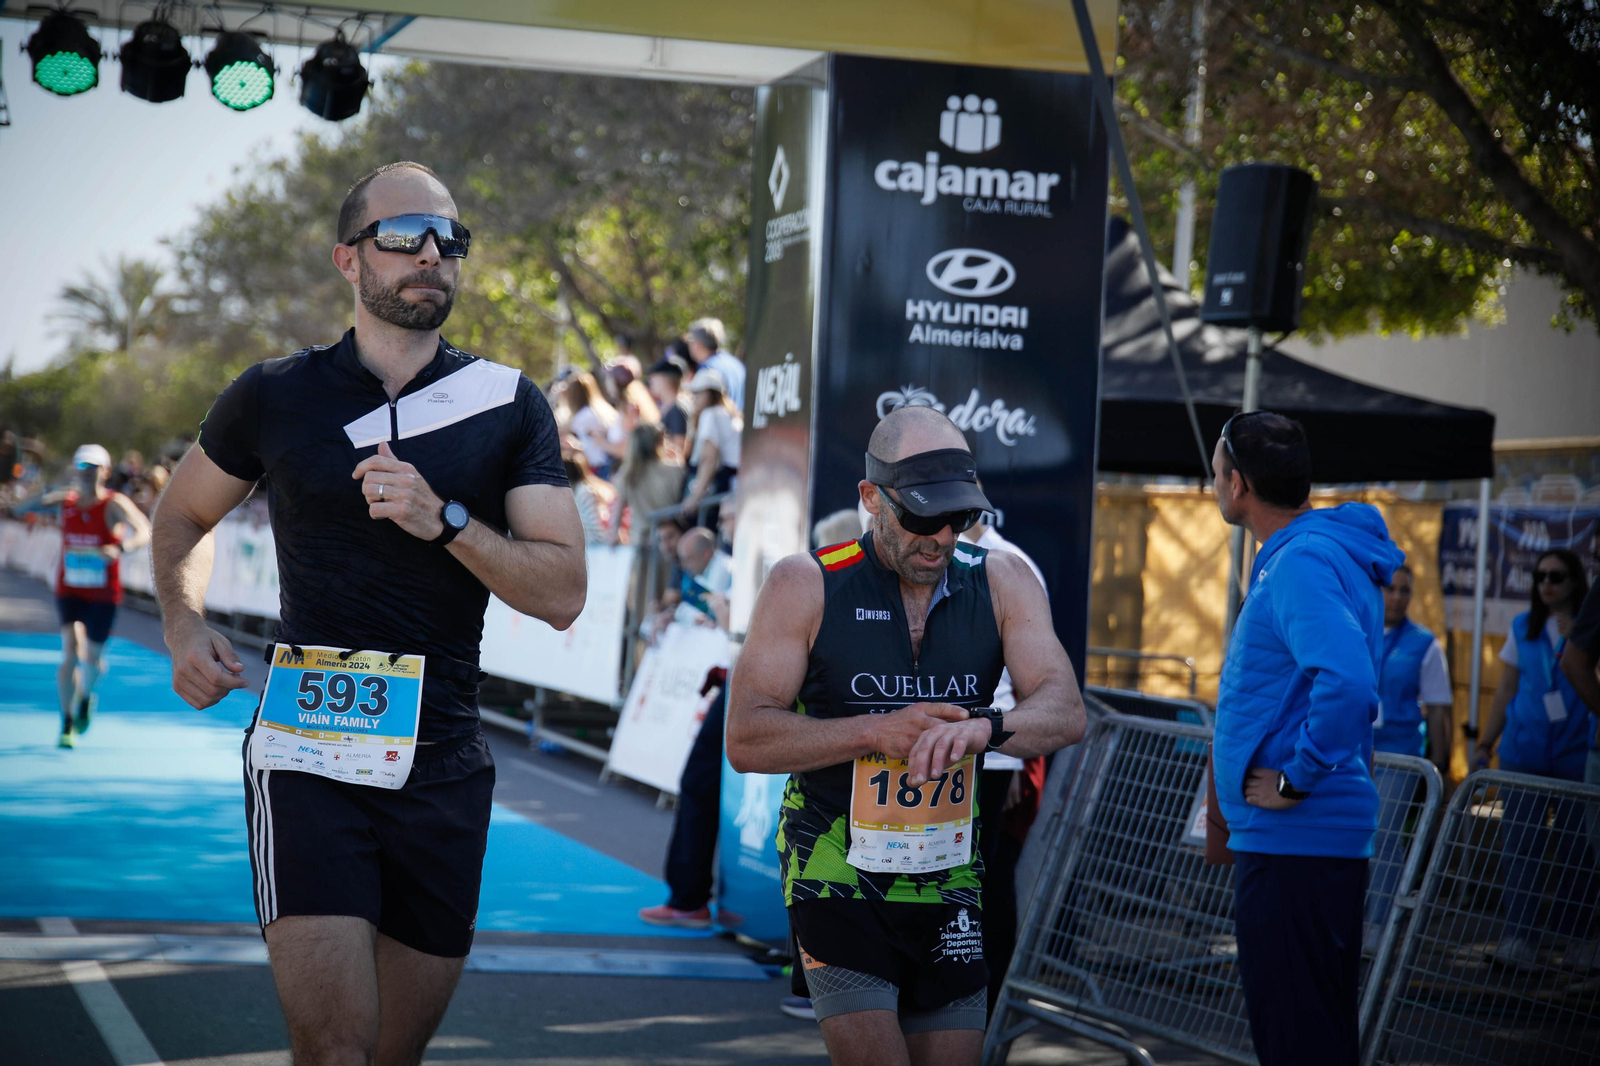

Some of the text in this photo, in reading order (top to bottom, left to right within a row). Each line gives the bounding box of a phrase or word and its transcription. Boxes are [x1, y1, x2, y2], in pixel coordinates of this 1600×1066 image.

[874, 151, 1060, 205] cajamar
[963, 197, 1053, 218] CAJA RURAL
[905, 299, 1028, 329] HYUNDAI
[908, 323, 1024, 351] Almerialva
[316, 658, 370, 670] Almería 2024
[296, 671, 389, 717] 593
[851, 673, 979, 698] CUELLAR
[298, 712, 380, 729] VIAÍN FAMILY
[298, 745, 323, 757] NEXAL
[869, 768, 965, 809] 1878
[886, 841, 910, 850] NEXAL
[942, 948, 971, 956] Tiempo
